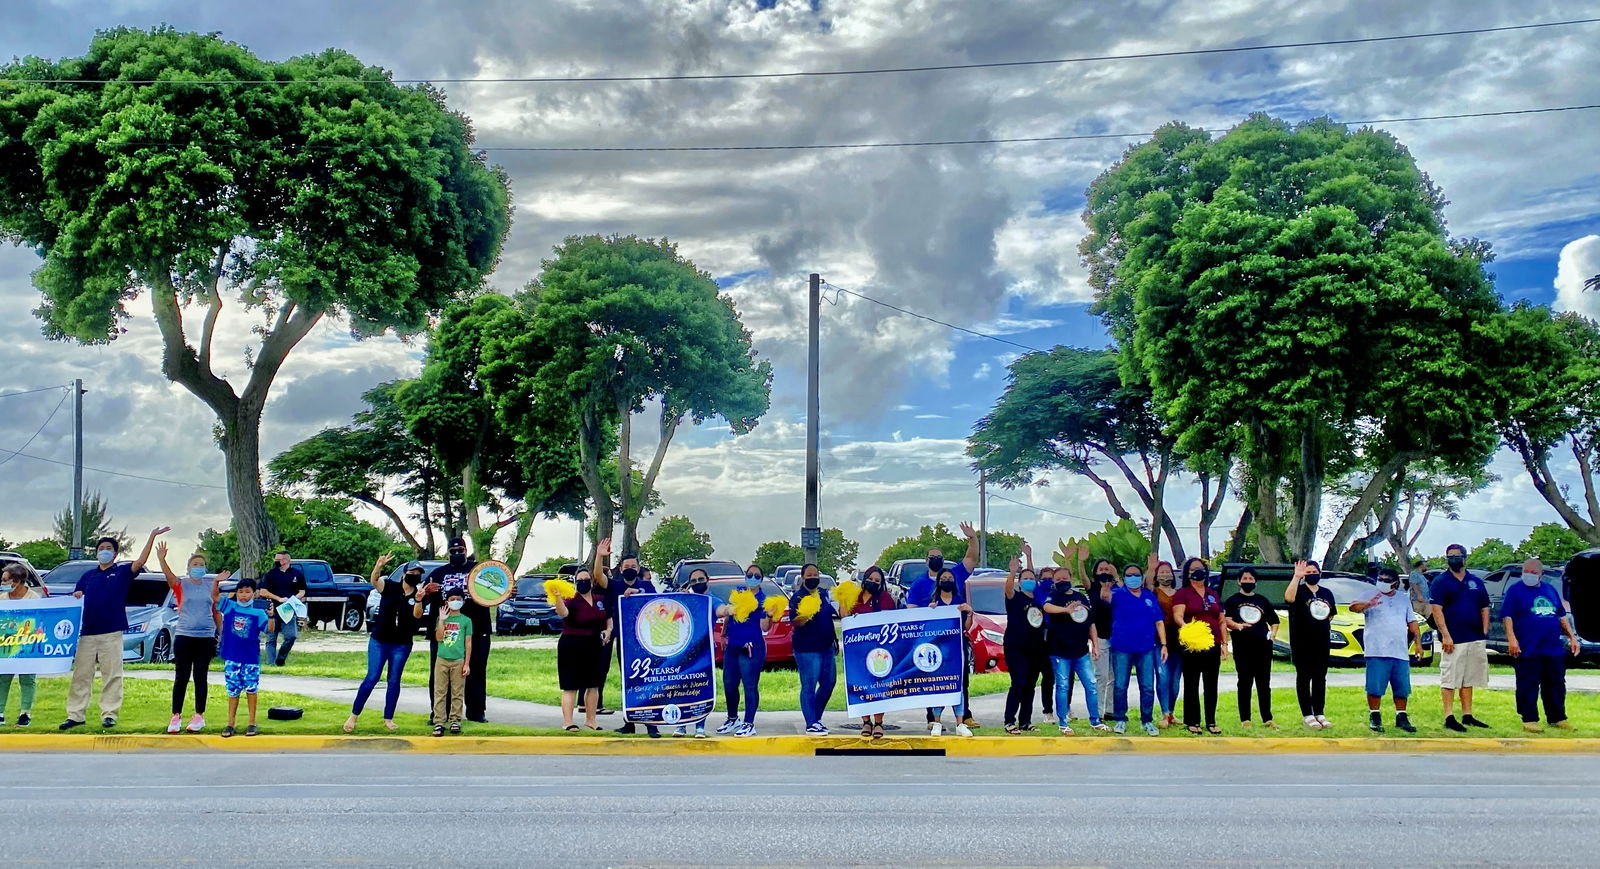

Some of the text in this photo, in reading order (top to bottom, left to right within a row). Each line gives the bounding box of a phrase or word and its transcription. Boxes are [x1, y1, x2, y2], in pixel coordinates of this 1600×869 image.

[844, 623, 926, 646] Celebrating 33 YEARS of
[901, 628, 961, 639] PUBLIC EDUCATION
[44, 643, 73, 655] DAY
[629, 657, 681, 679] 33 YEARS of
[644, 675, 667, 683] PUBLIC
[853, 684, 868, 692] Eew
[903, 677, 912, 686] ye
[666, 690, 672, 699] of
[673, 688, 701, 698] Knowledge
[909, 685, 921, 693] me
